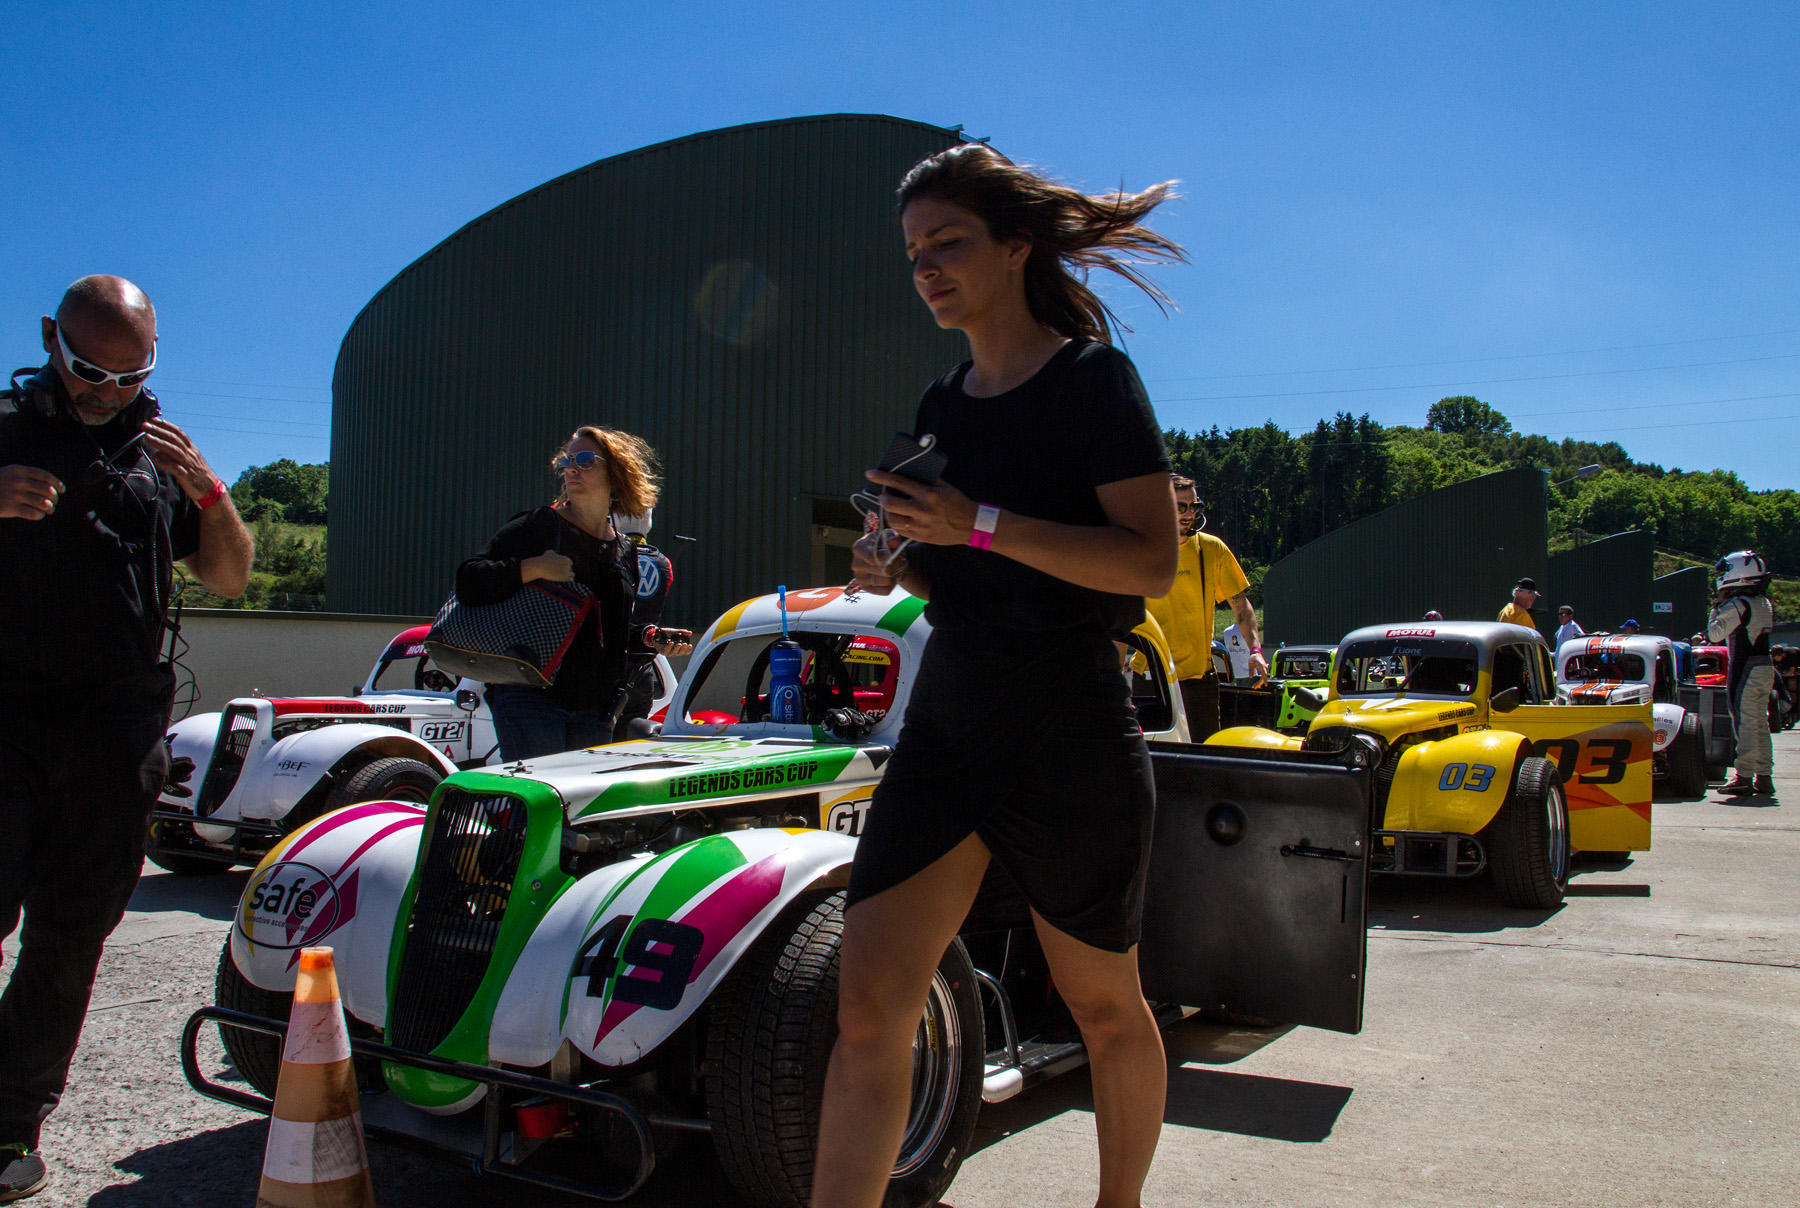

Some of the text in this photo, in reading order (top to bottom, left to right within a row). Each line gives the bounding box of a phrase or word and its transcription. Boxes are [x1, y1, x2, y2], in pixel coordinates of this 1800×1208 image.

[325, 704, 406, 713] LEGENDS CARS CUP
[1438, 707, 1475, 721] LEGENDS CARS CUP
[420, 721, 465, 740] GT2i
[1439, 762, 1496, 792] 03
[1531, 739, 1632, 784] 03
[669, 761, 818, 798] LEGENDS CARS CUP
[248, 877, 317, 919] safe
[570, 914, 704, 1010] 49
